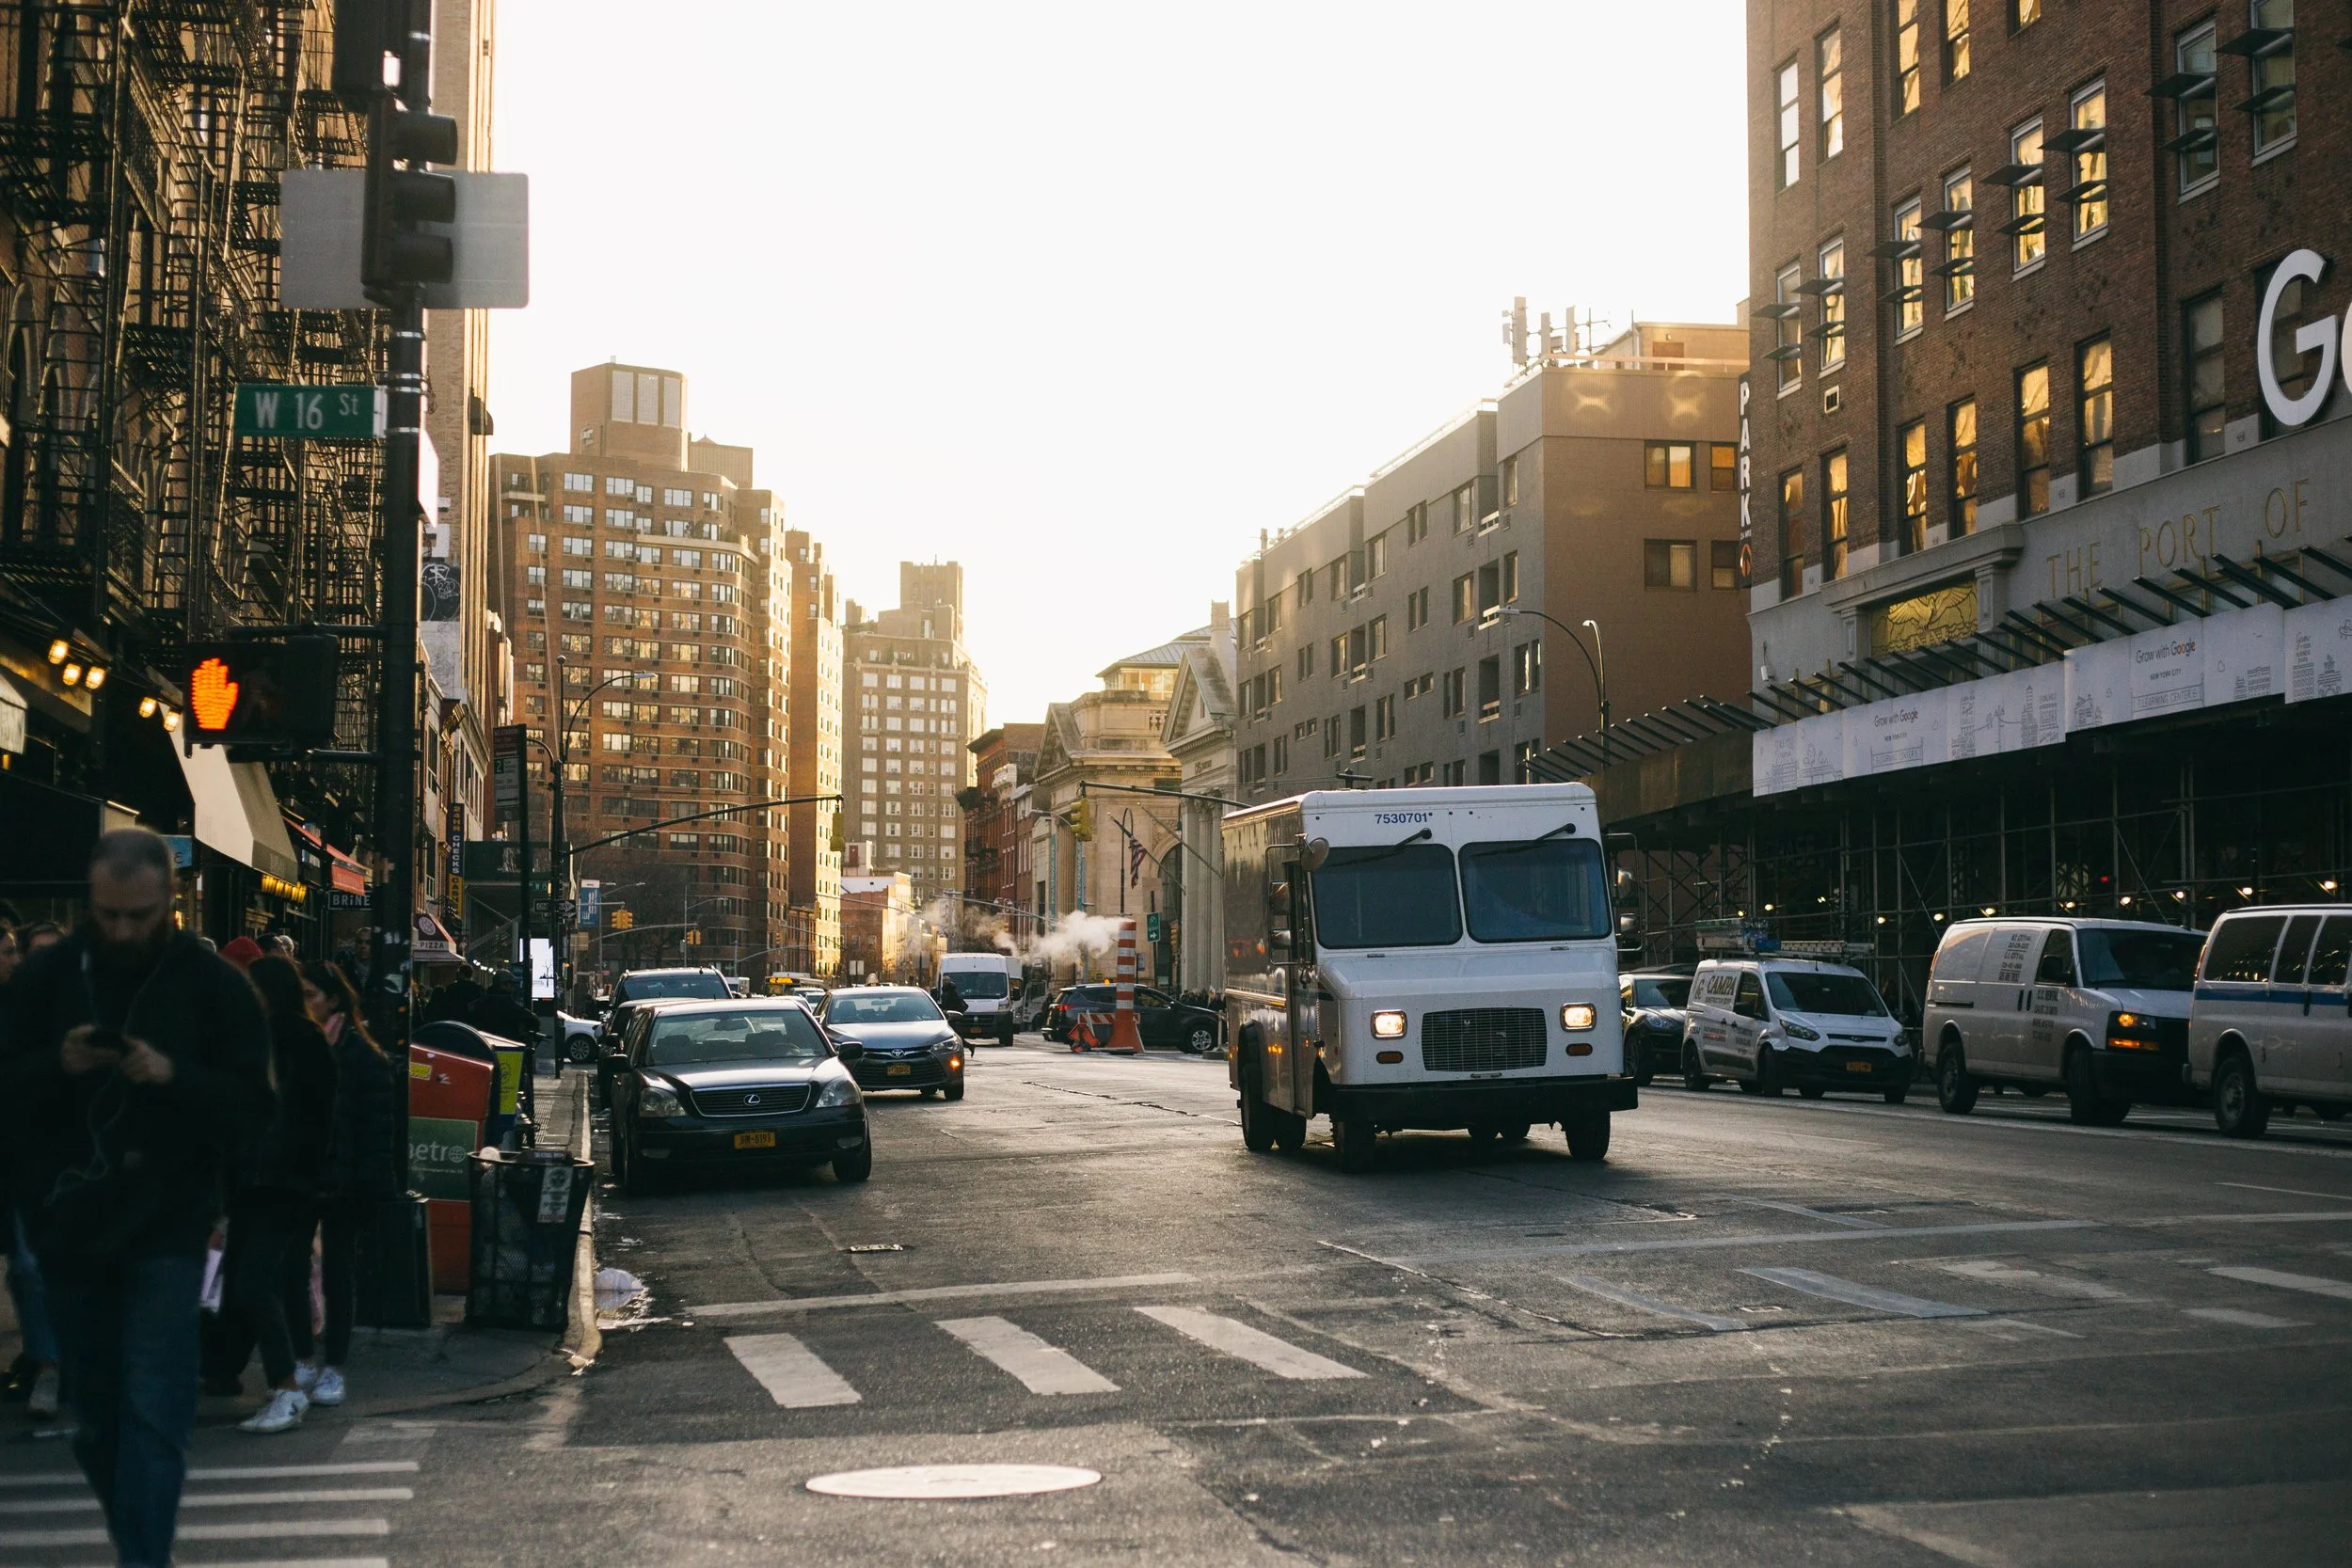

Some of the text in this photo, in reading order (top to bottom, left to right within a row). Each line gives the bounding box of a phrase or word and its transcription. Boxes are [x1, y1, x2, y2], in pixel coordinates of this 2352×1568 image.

[2258, 248, 2352, 425] G
[255, 391, 358, 430] W 16 St
[1740, 380, 1751, 528] PARK
[2047, 478, 2309, 599] THE PORT OF
[2137, 638, 2196, 664] Grow with Google
[2171, 668, 2182, 676] CITY
[2170, 689, 2191, 703] CENTER
[1874, 715, 1888, 727] Grow
[1899, 708, 1918, 723] Google
[496, 760, 502, 773] 2
[1375, 813, 1428, 824] 7530701
[452, 834, 460, 874] CHECKS
[1707, 974, 1737, 995] CAMPA
